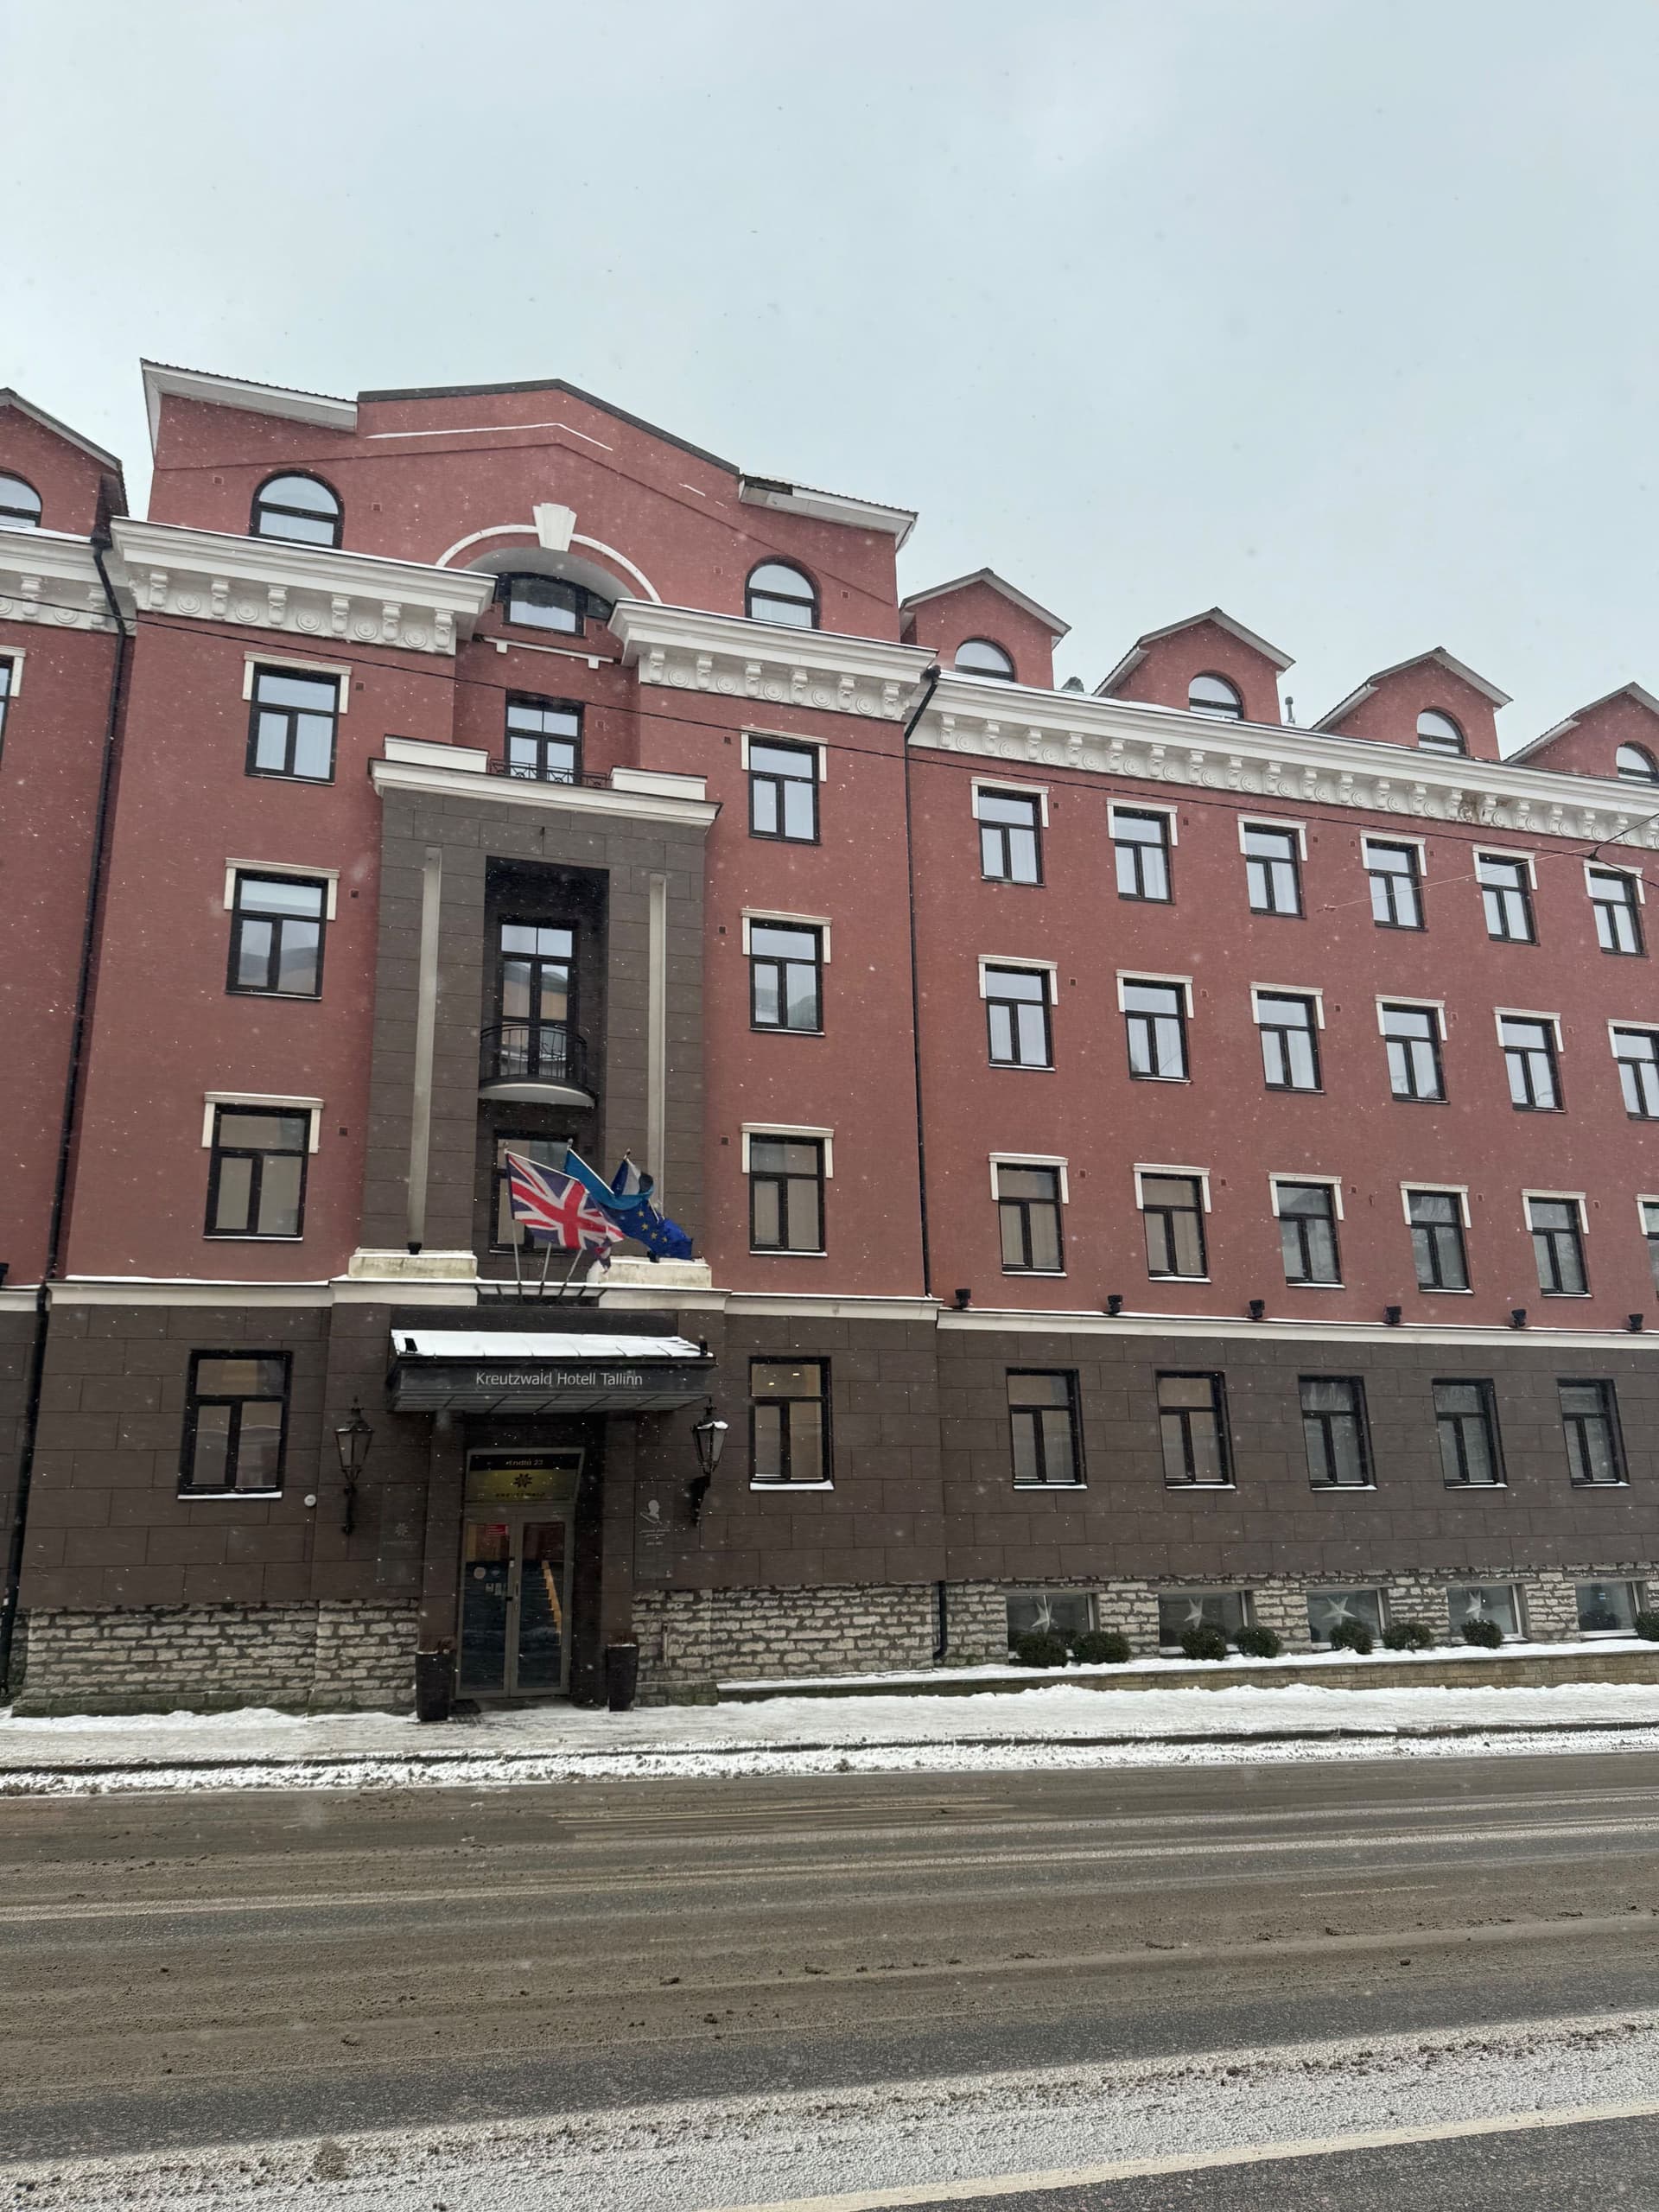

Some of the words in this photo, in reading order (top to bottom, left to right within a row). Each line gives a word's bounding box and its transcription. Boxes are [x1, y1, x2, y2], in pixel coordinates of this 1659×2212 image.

[476, 1371, 552, 1385] Kreutzwald
[557, 1371, 595, 1385] Hotell
[600, 1371, 643, 1385] Tallinn
